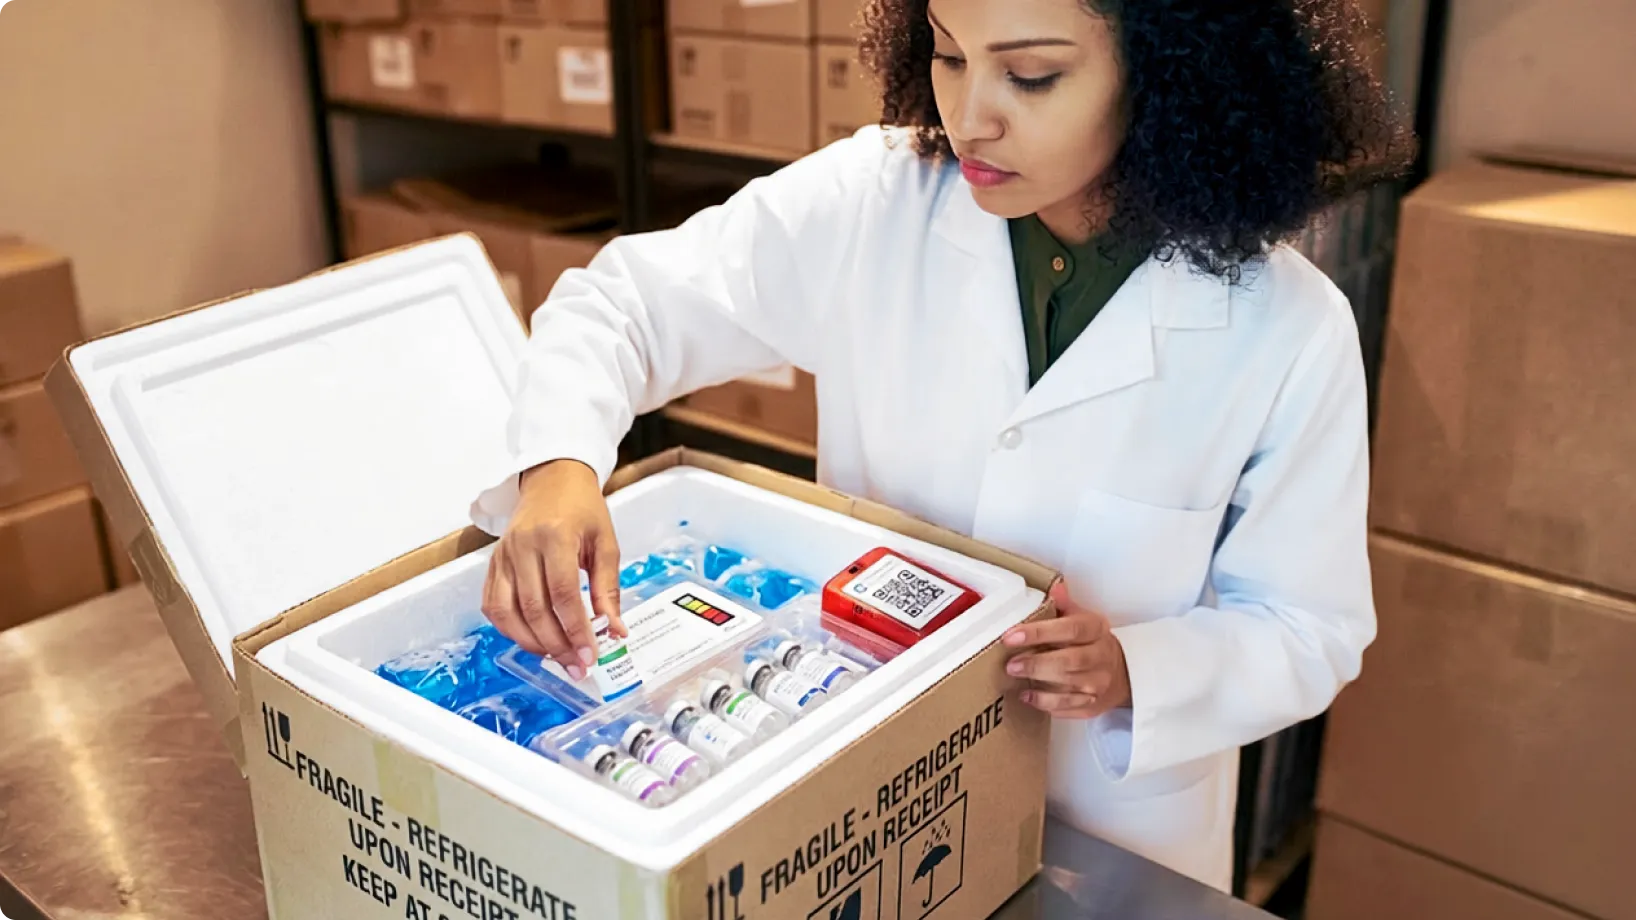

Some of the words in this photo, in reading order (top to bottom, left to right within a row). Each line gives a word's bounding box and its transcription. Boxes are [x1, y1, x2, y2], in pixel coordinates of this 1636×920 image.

[296, 750, 385, 829] FRAGILE
[407, 816, 577, 920] REFRIGERATE
[348, 817, 411, 880] UPON
[760, 806, 857, 904] FRAGILE
[876, 695, 1004, 818] REFRIGERATE
[816, 829, 877, 899] UPON
[883, 763, 963, 849] RECEIPT
[342, 854, 397, 908] KEEP
[405, 894, 431, 920] AT
